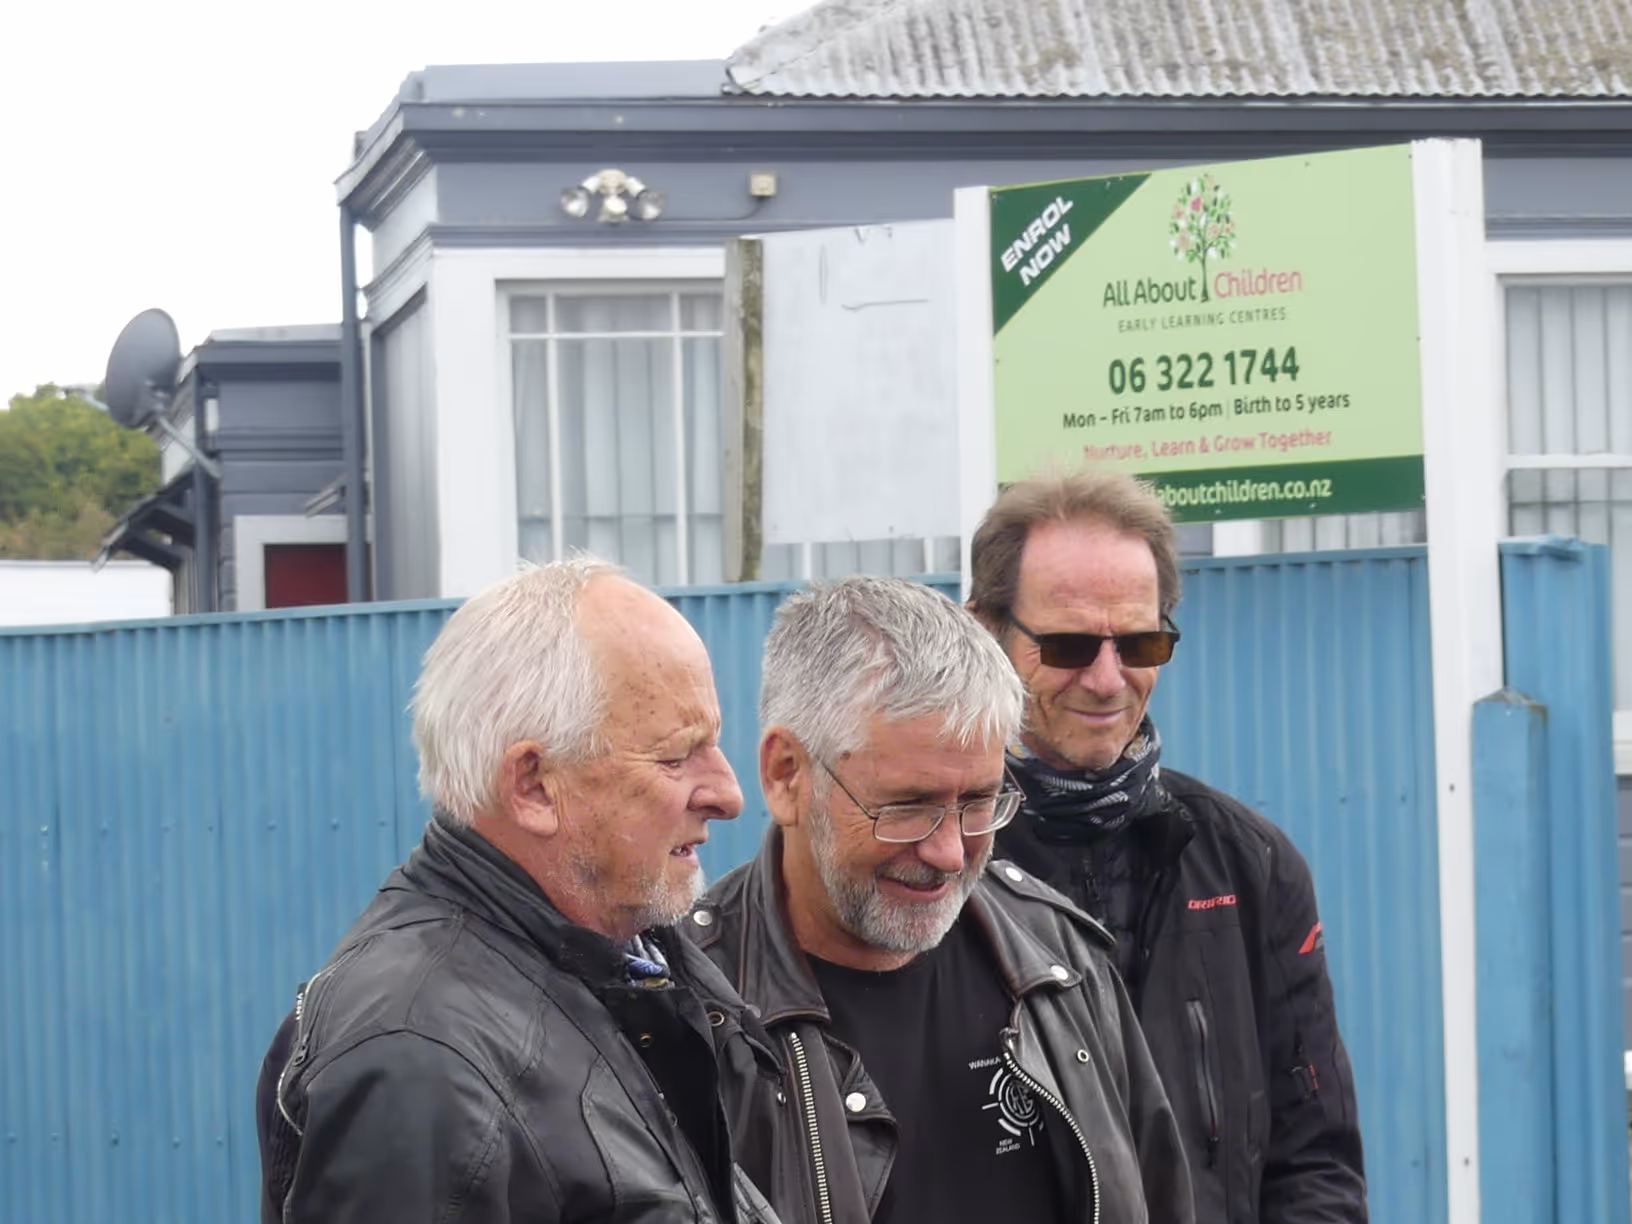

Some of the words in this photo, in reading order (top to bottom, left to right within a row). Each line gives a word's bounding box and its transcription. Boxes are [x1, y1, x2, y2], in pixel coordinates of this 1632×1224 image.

[1000, 196, 1074, 273] ENROL
[1018, 223, 1071, 287] NOW
[1103, 281, 1130, 307] All
[1133, 277, 1197, 304] About
[1214, 267, 1303, 298] Children
[1118, 317, 1157, 333] EARLY
[1161, 312, 1225, 330] LEARNING
[1229, 306, 1287, 324] CENTRES
[1108, 356, 1146, 395] 06
[1156, 352, 1215, 391] 322
[1224, 346, 1300, 385] 1744
[1063, 412, 1096, 429] Mon
[1111, 406, 1131, 425] Fri
[1134, 406, 1165, 423] 7am
[1169, 405, 1186, 421] to
[1189, 401, 1223, 422] 6pm
[1234, 395, 1272, 415] Birth
[1275, 396, 1291, 412] to
[1296, 393, 1305, 411] 5
[1308, 393, 1351, 414] years
[1152, 440, 1195, 457] Learn
[1200, 435, 1210, 453] &
[1214, 434, 1256, 453] Grow
[1258, 428, 1333, 453] Together
